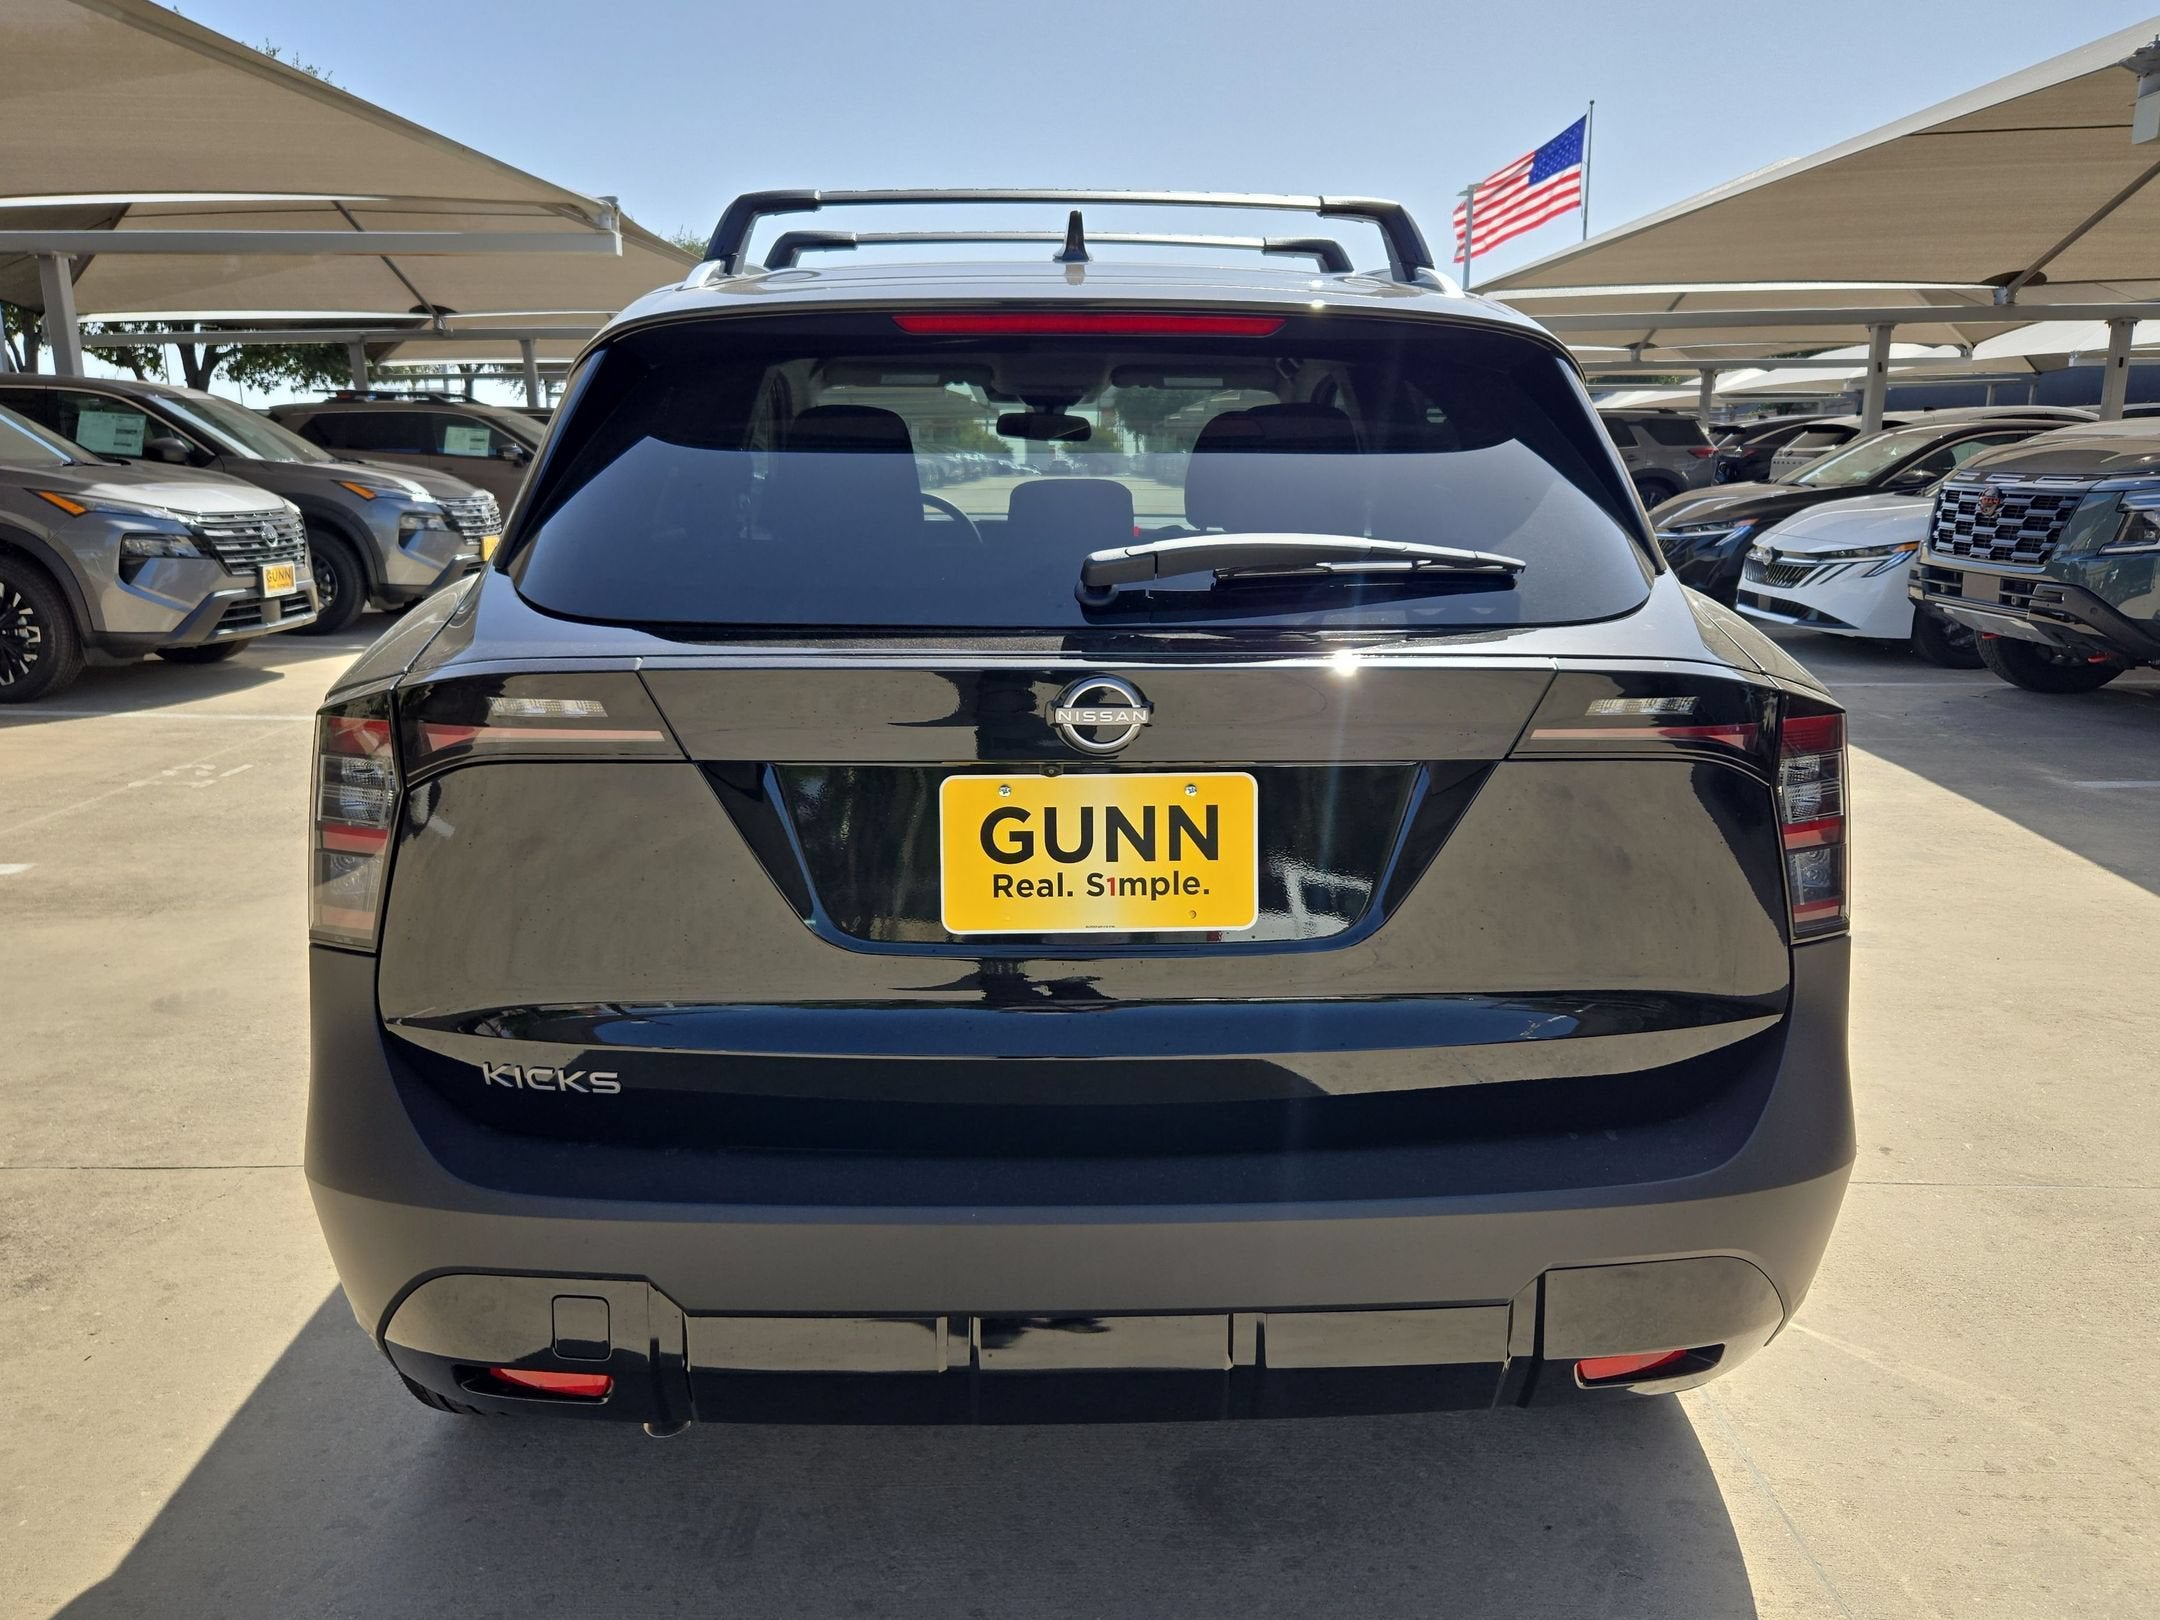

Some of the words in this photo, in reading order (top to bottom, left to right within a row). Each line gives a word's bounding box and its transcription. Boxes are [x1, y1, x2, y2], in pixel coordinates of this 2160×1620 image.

[1058, 710, 1146, 722] NISSAN
[980, 804, 1219, 864] GUNN
[993, 871, 1074, 898] Real.
[1086, 870, 1210, 901] S1mple.
[482, 1062, 622, 1094] KICKS
